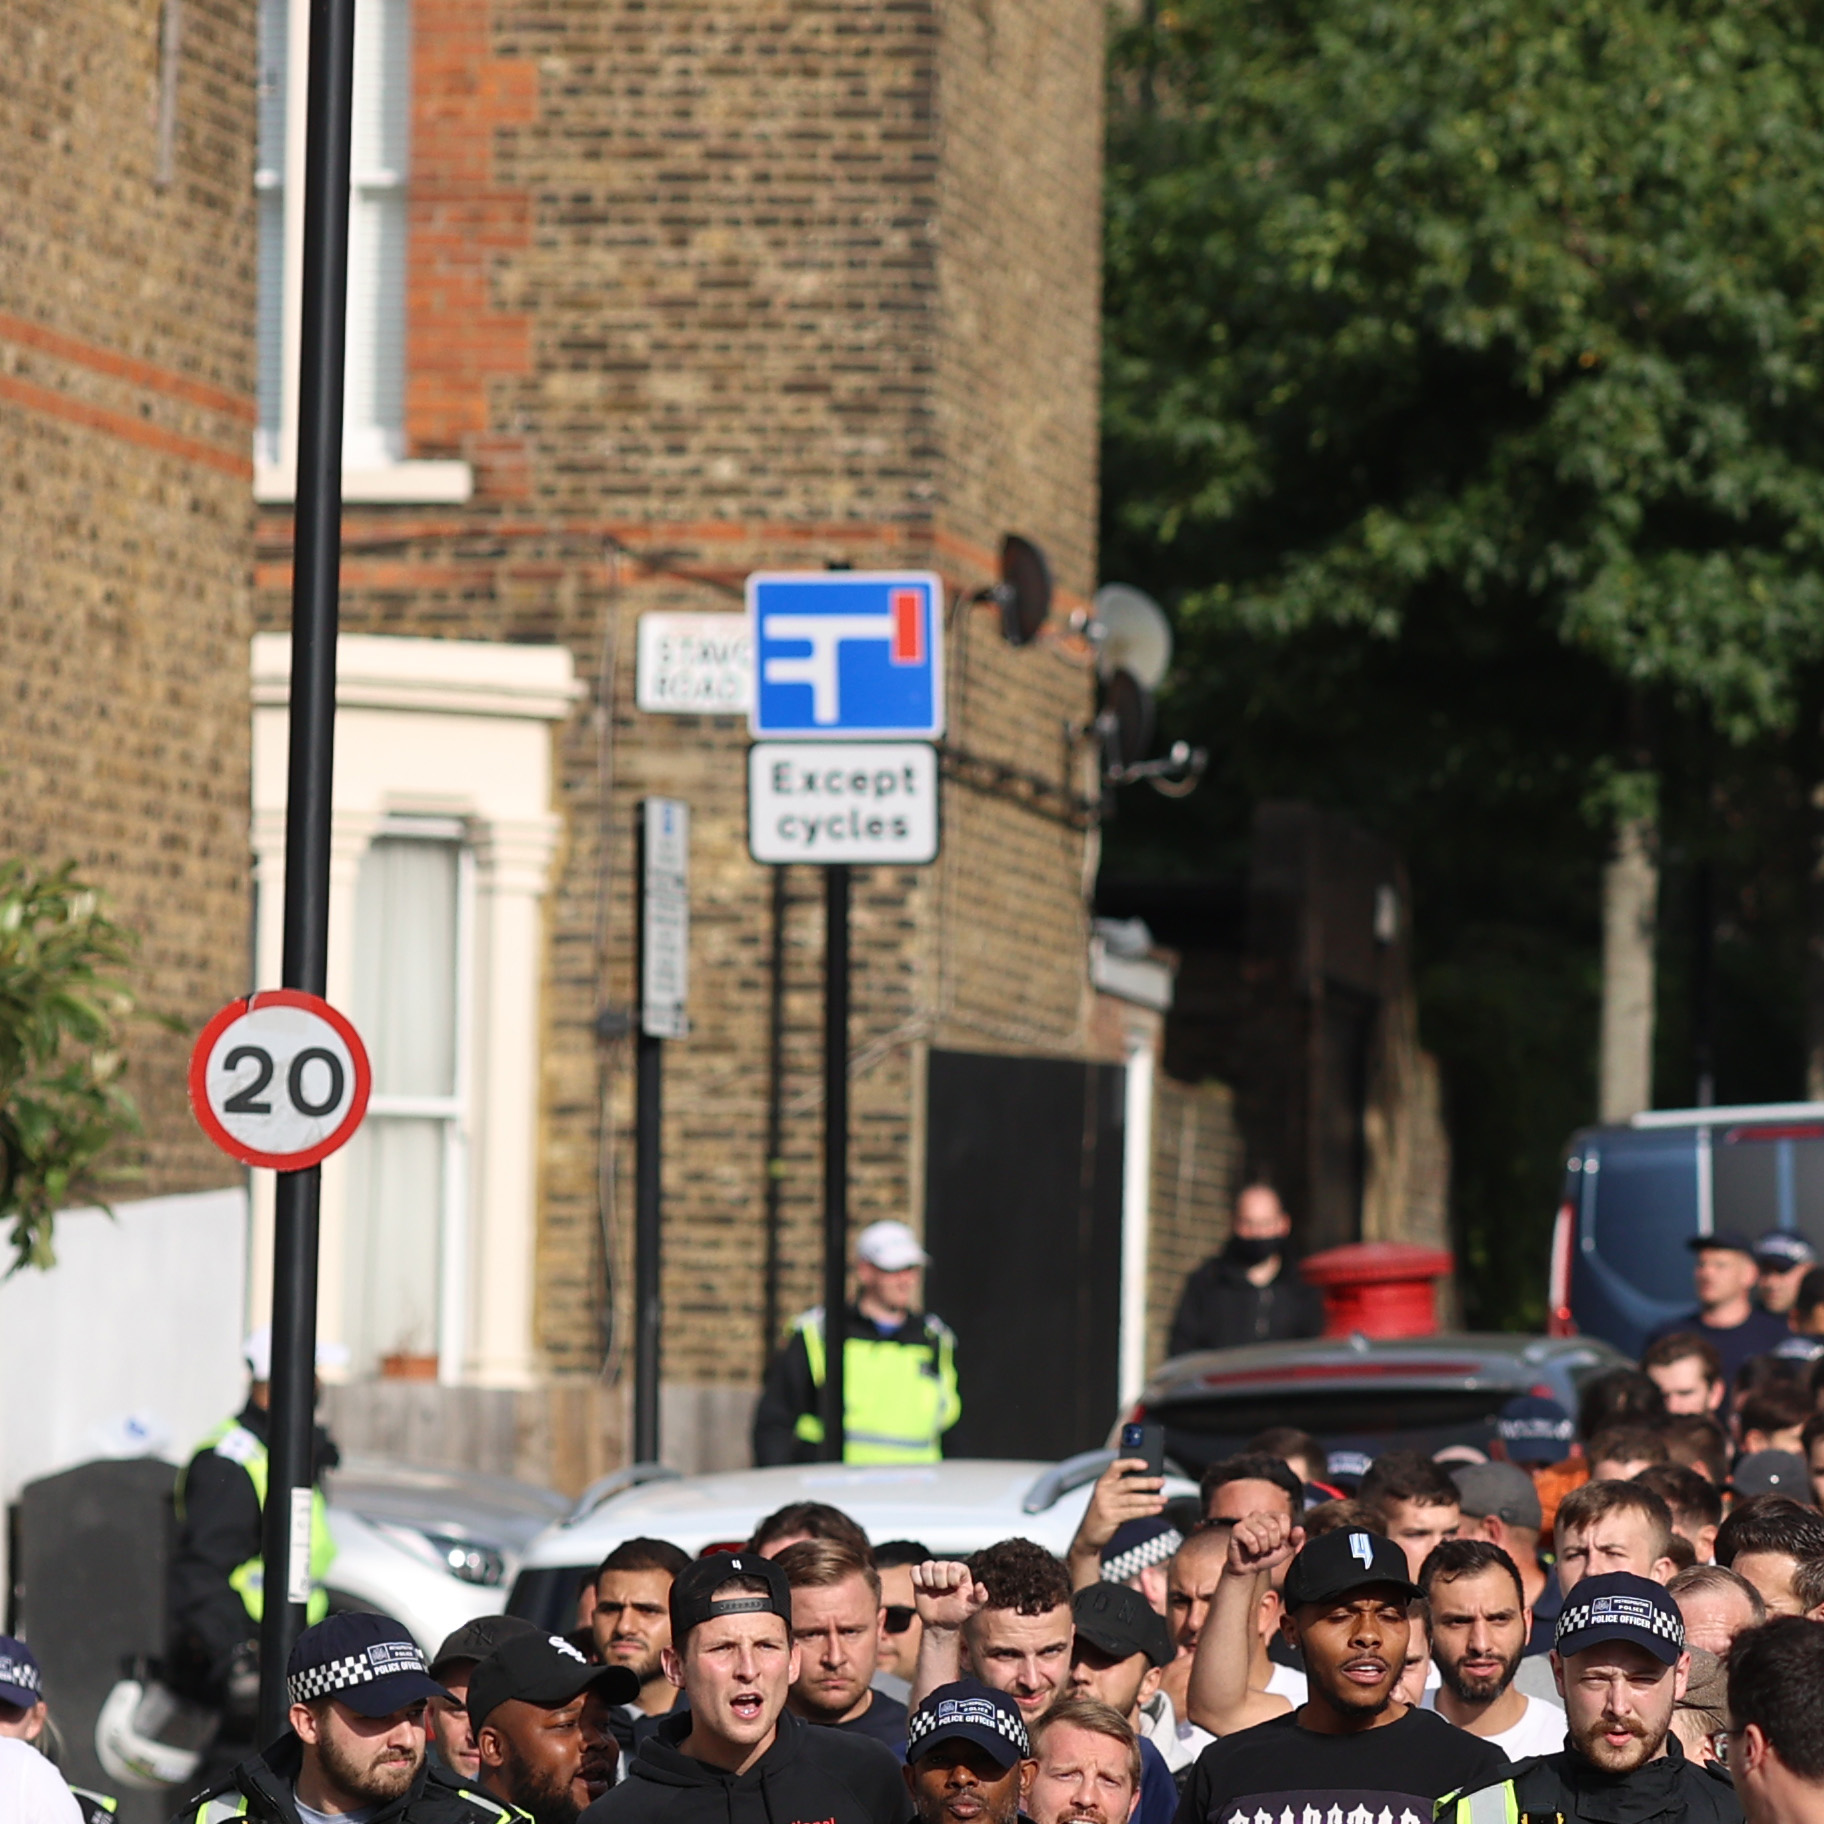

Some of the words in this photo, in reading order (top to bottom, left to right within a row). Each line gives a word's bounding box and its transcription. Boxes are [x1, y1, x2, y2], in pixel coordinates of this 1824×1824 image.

[770, 761, 918, 797] Except
[776, 809, 910, 847] cycles
[222, 1044, 345, 1117] 20
[1591, 1614, 1619, 1625] POLICE
[1619, 1614, 1651, 1629] OFFICER
